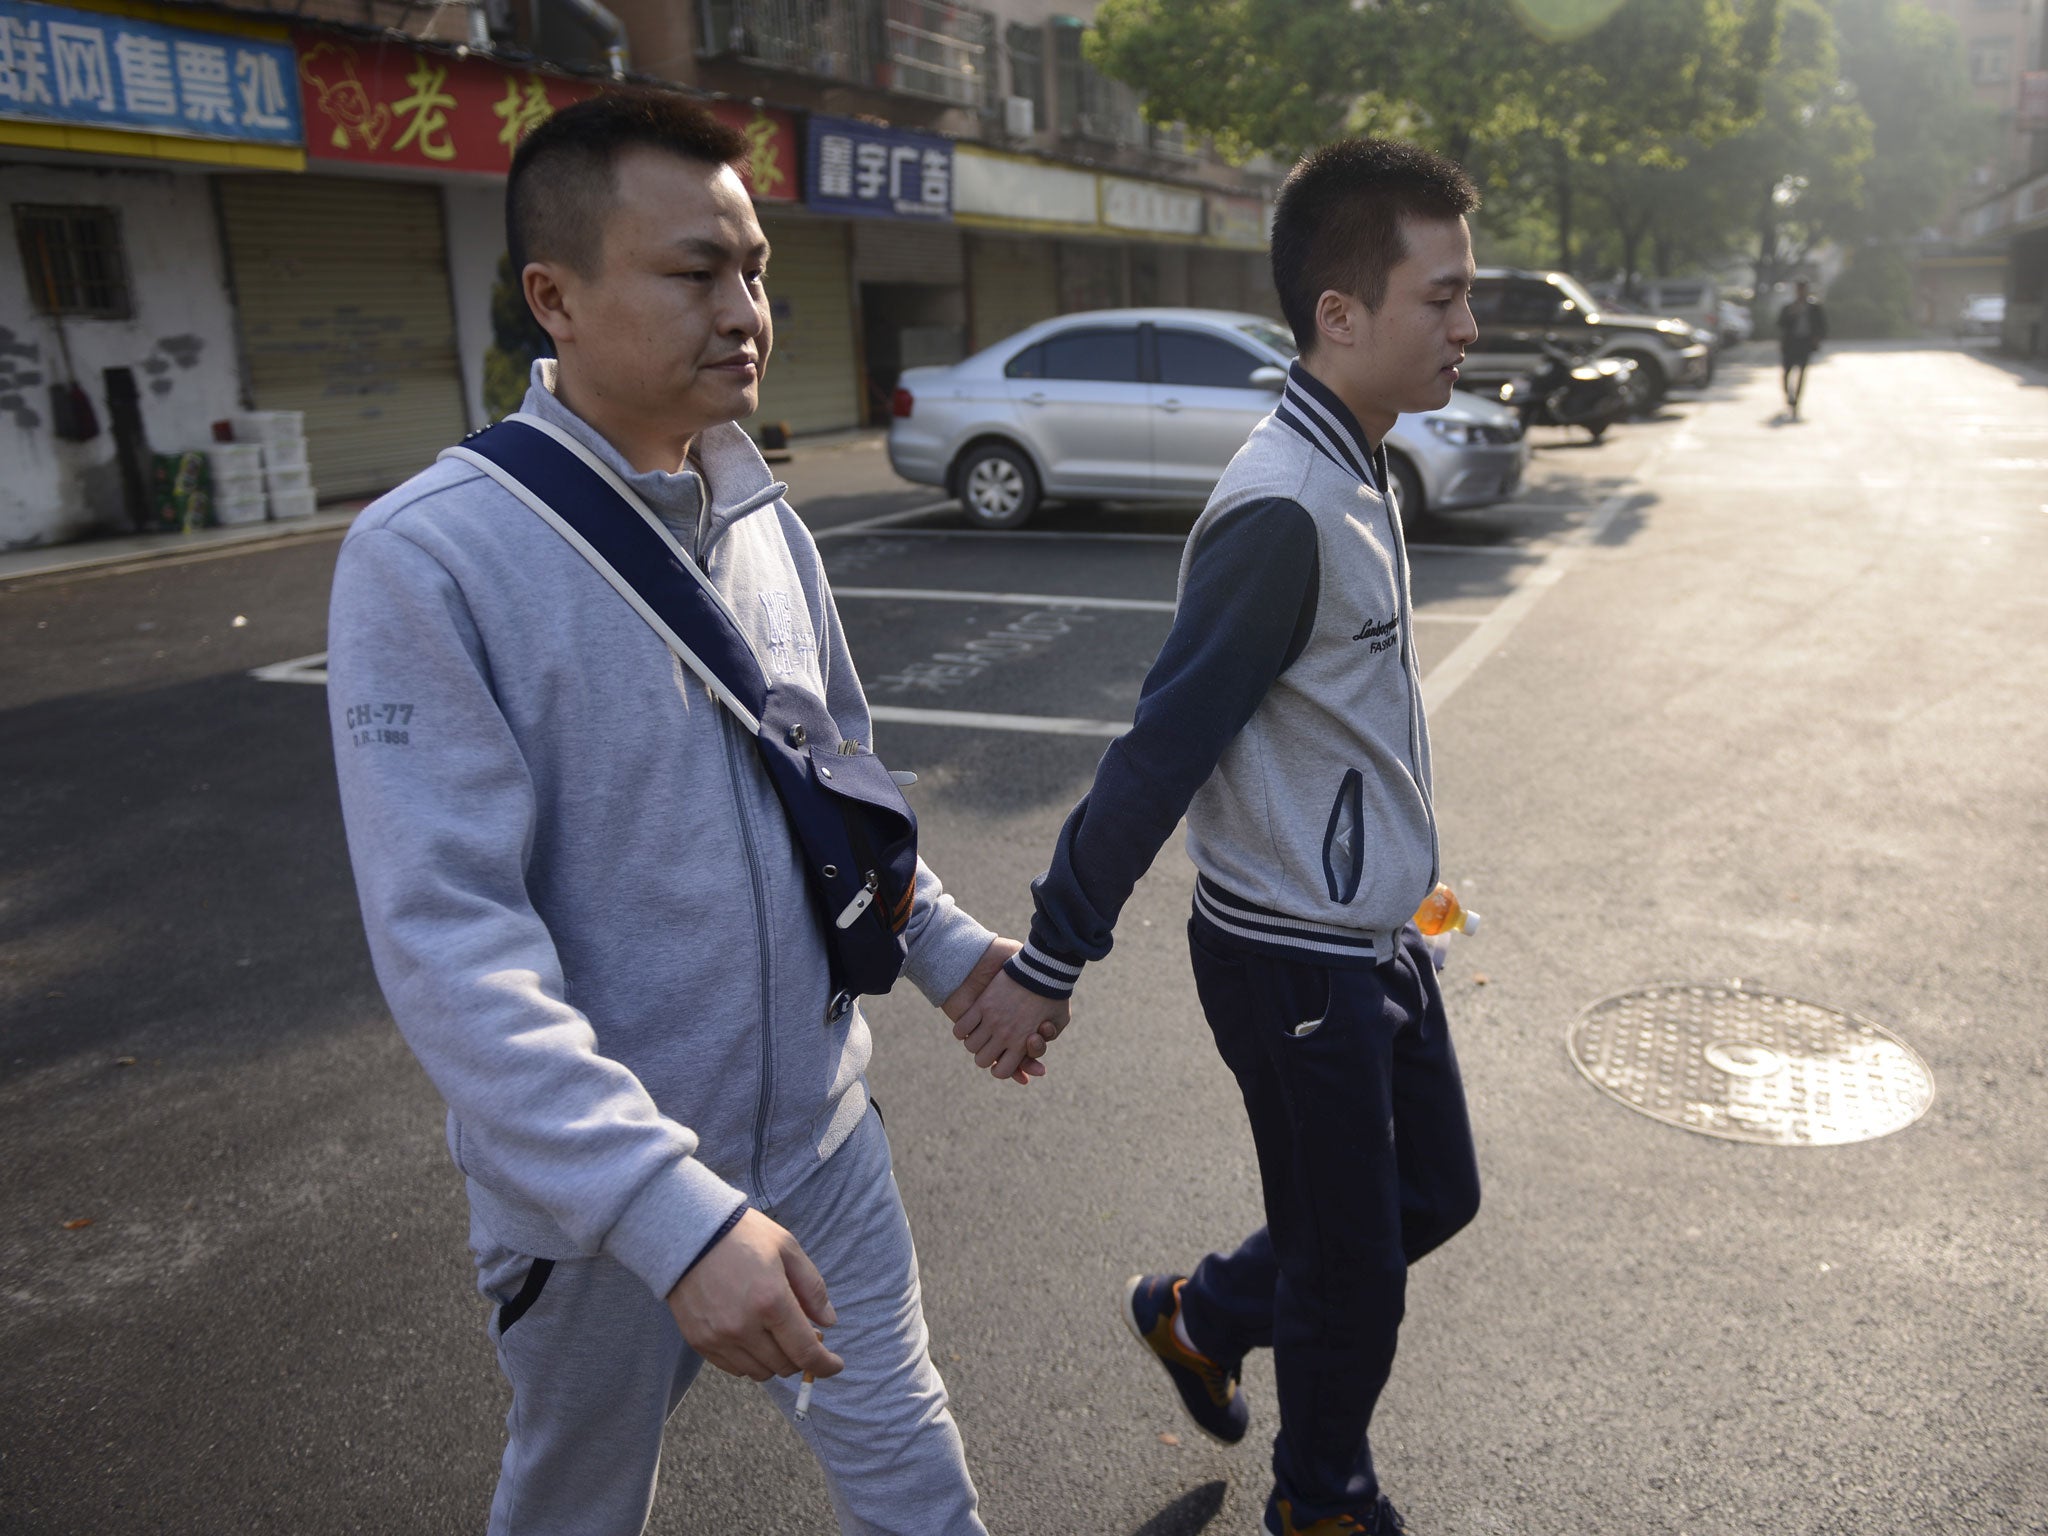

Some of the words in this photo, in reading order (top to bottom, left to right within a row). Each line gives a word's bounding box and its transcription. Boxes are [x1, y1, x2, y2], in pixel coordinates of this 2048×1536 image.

[0, 15, 290, 129] 联网售票处
[346, 703, 414, 729] CH-77
